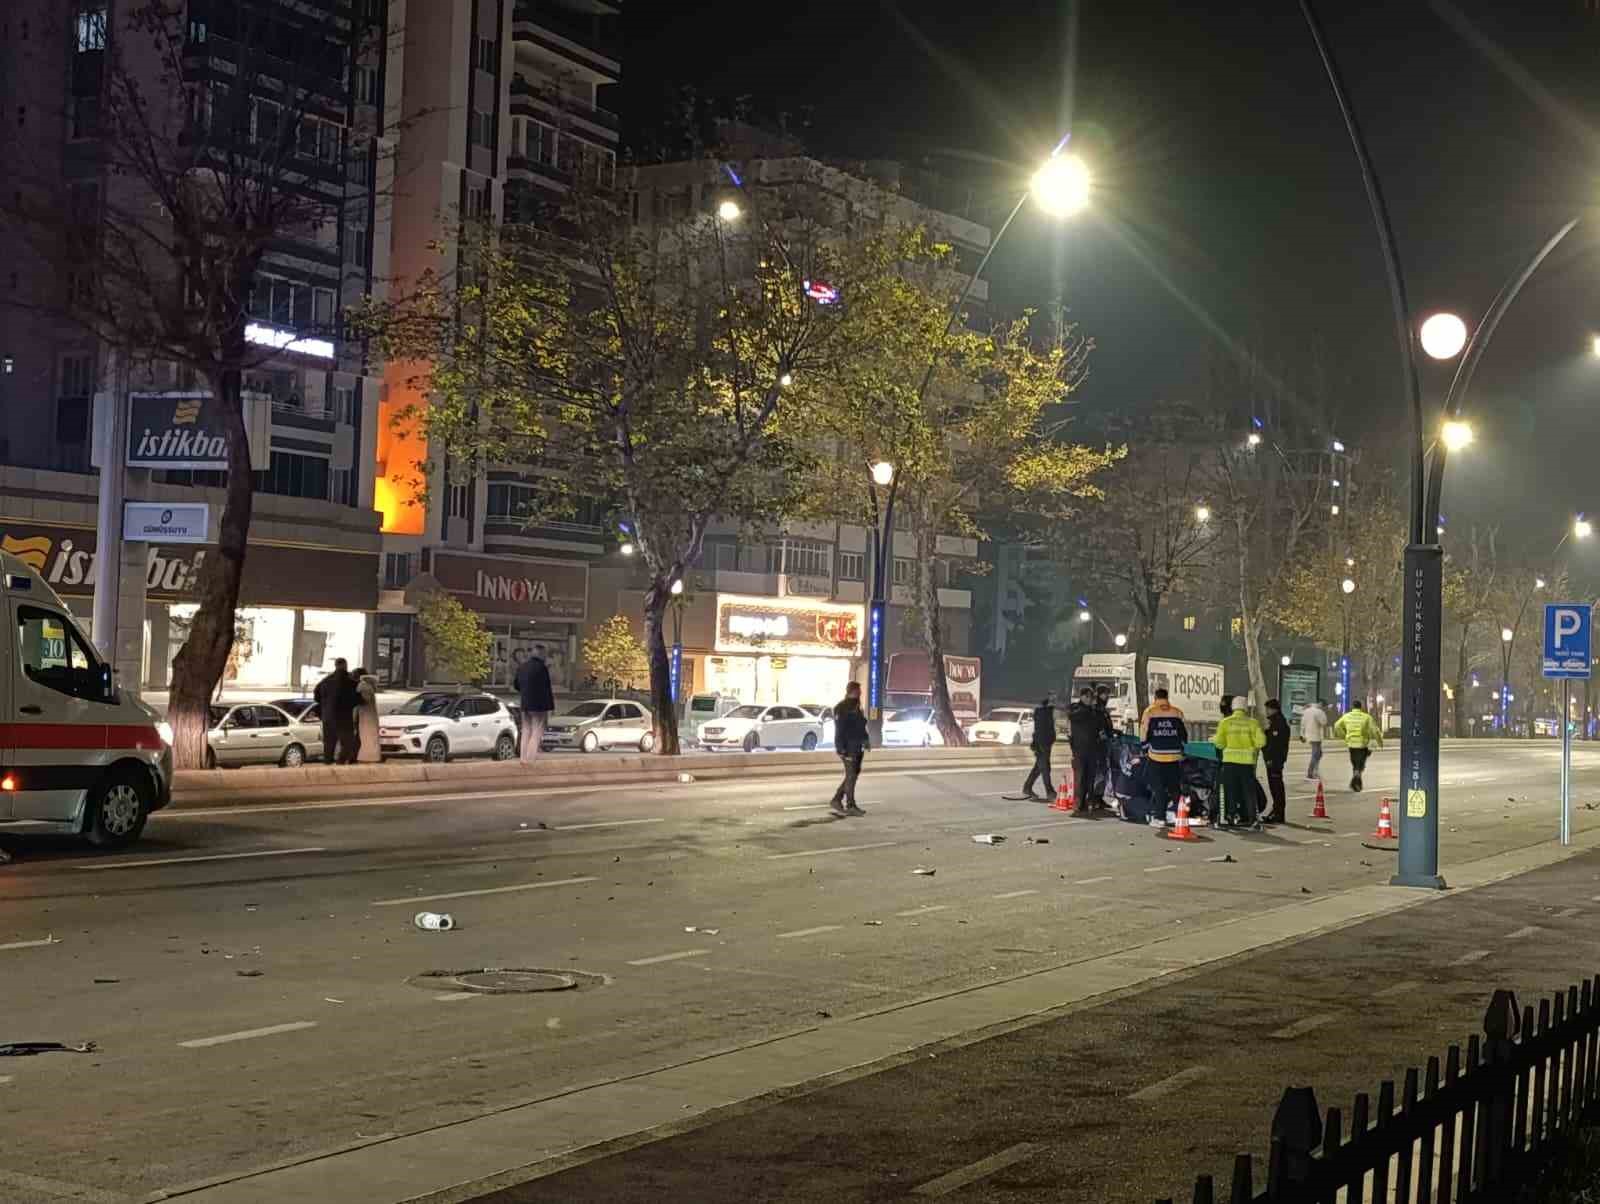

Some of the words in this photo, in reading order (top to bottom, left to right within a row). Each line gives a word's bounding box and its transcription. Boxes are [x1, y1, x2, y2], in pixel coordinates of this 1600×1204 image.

[137, 428, 228, 457] istikba
[476, 568, 549, 602] INNOVA
[1554, 609, 1581, 649] P
[1174, 671, 1220, 699] rapsodi
